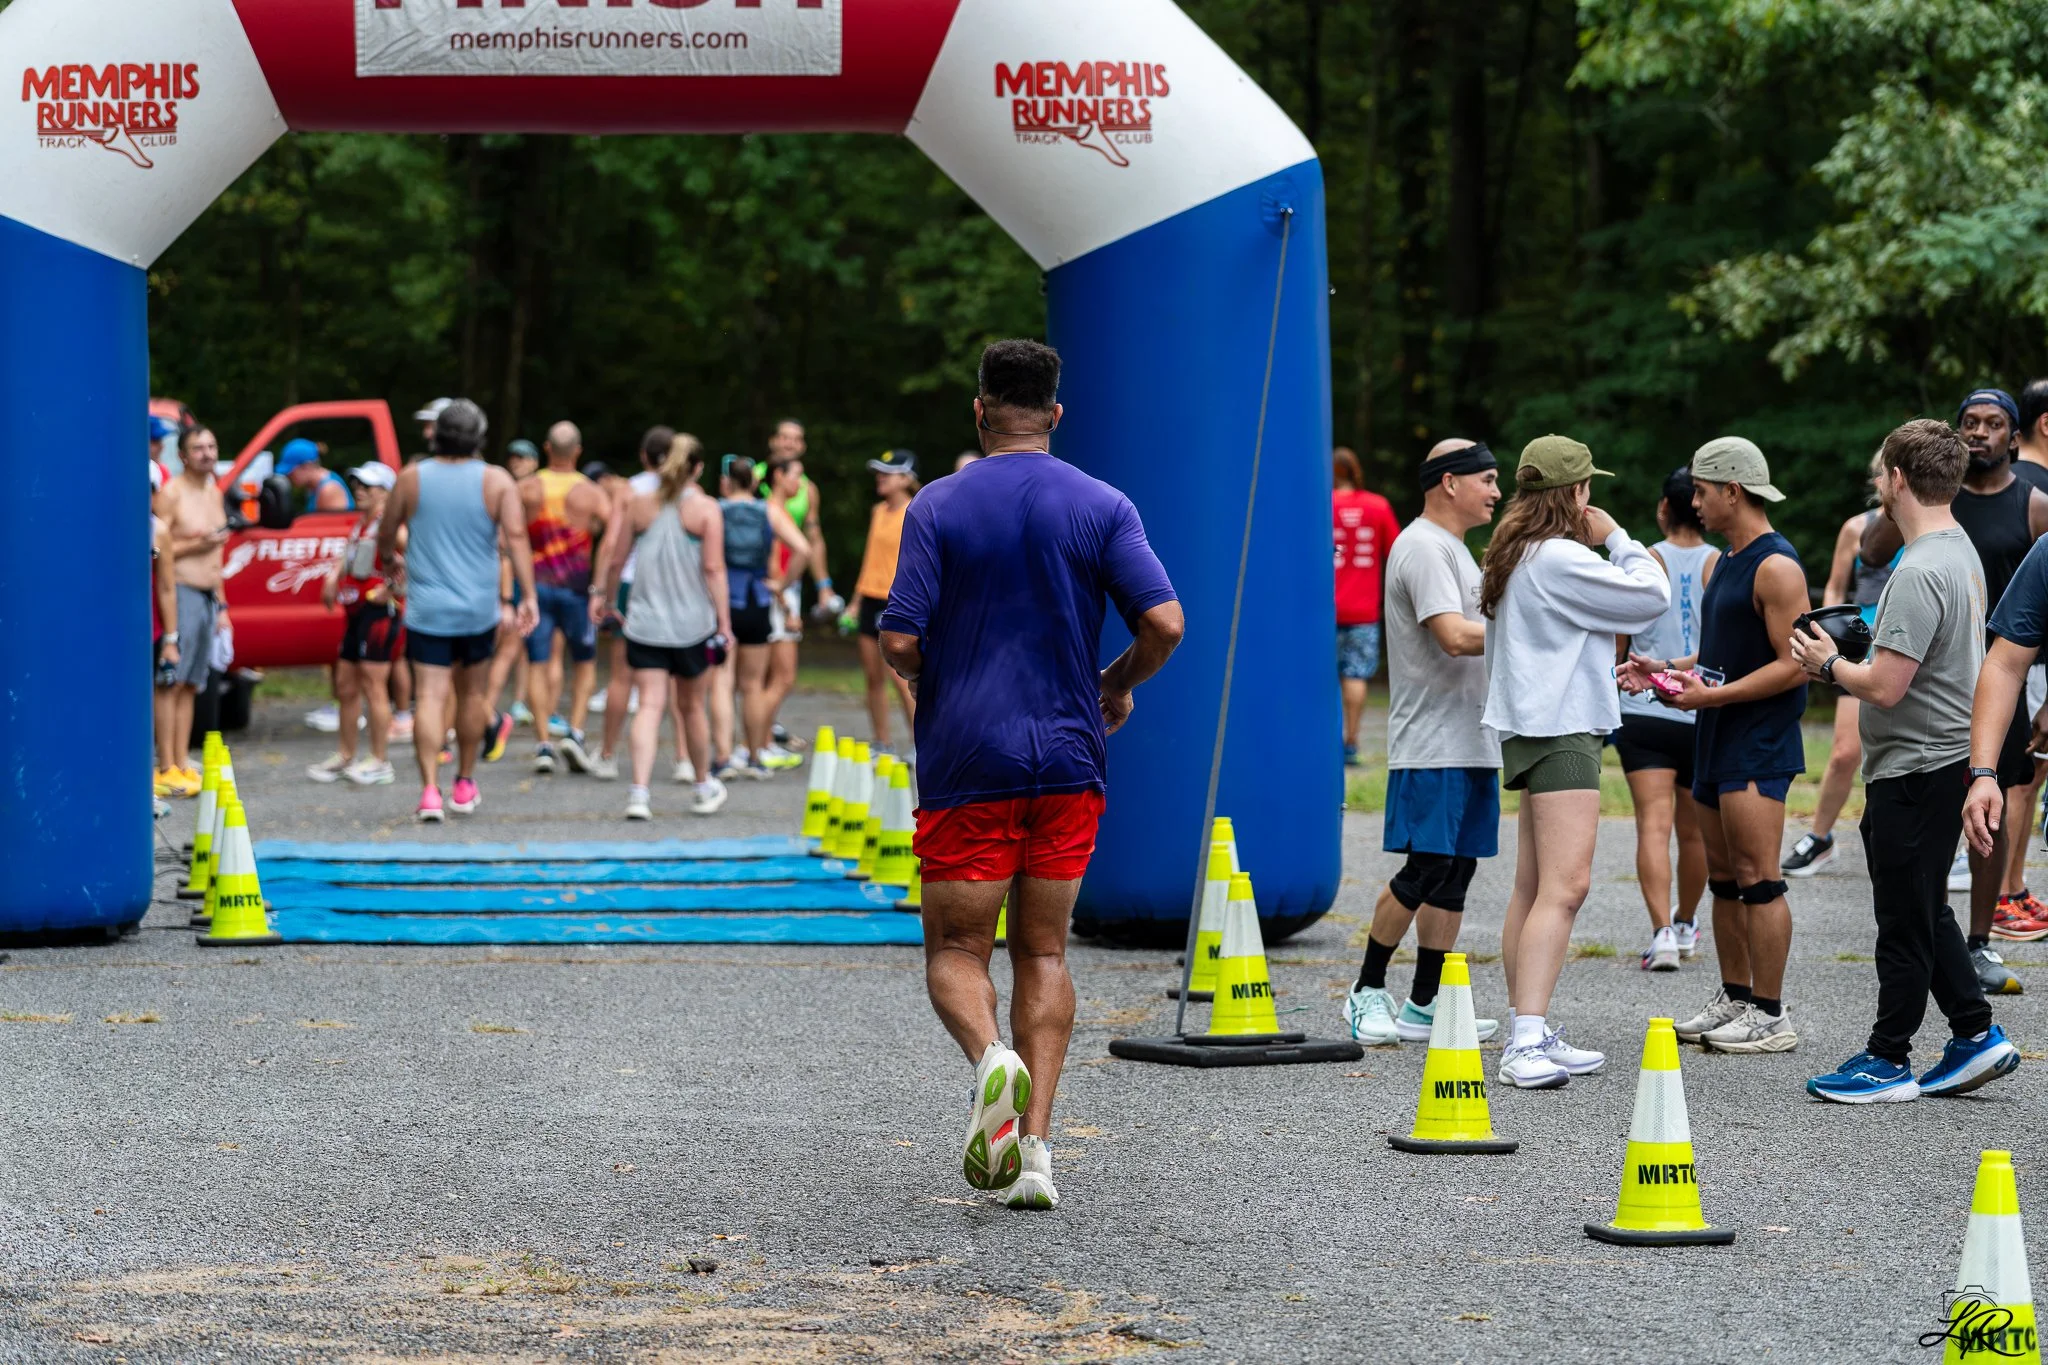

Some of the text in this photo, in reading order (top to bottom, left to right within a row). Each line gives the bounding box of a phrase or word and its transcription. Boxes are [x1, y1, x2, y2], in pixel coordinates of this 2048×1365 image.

[450, 26, 747, 53] memphisrunners.com
[22, 63, 200, 101] MEMPHIS
[995, 61, 1170, 97] MEMPHIS
[38, 101, 178, 128] RUNNERS
[1012, 98, 1152, 126] RUNNERS
[39, 135, 177, 149] TRACK CLUB
[1015, 133, 1152, 145] TRACK CLUB
[257, 538, 318, 560] FLEET
[219, 894, 262, 908] MRTC
